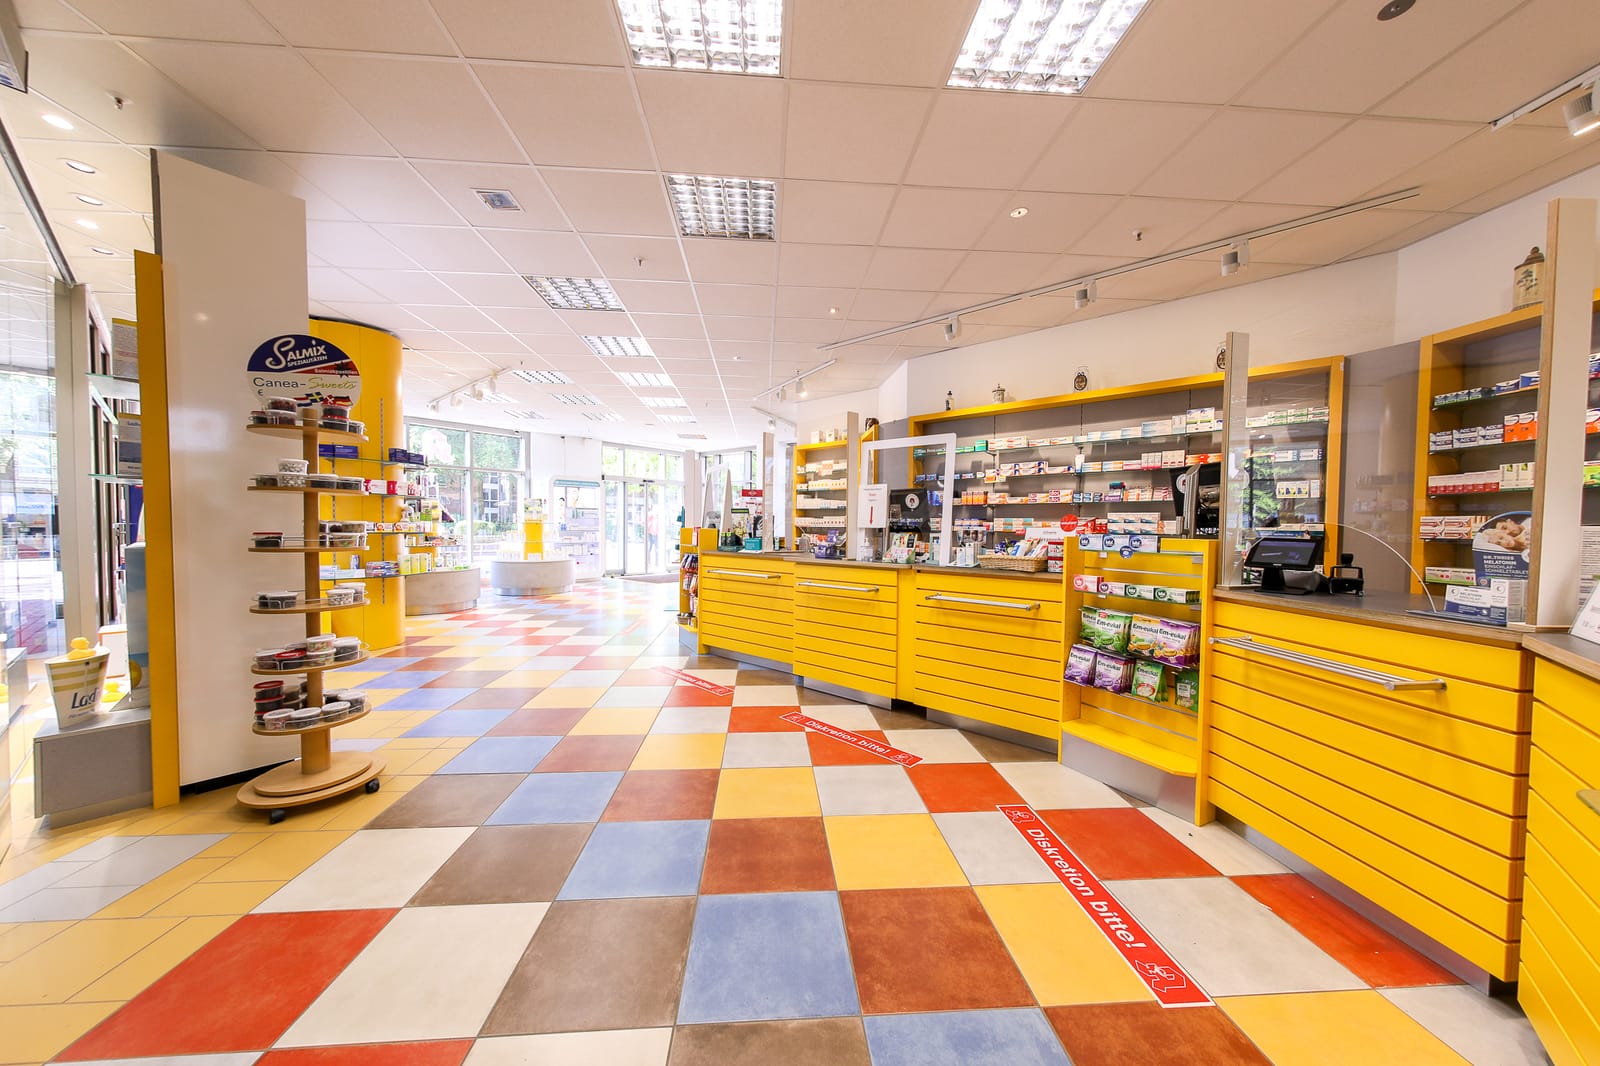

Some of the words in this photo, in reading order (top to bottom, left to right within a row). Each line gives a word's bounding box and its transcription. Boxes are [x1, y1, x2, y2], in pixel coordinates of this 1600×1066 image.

[287, 355, 328, 368] SPEZIALITÄTEN
[1132, 623, 1159, 635] Em-eukal
[1159, 628, 1187, 641] Em-eukal
[1097, 660, 1122, 672] Em-eukal
[805, 720, 858, 742] Diskretion
[858, 740, 892, 754] bitte!
[1026, 828, 1095, 897] Diskretion
[1088, 901, 1148, 948] bitte!
